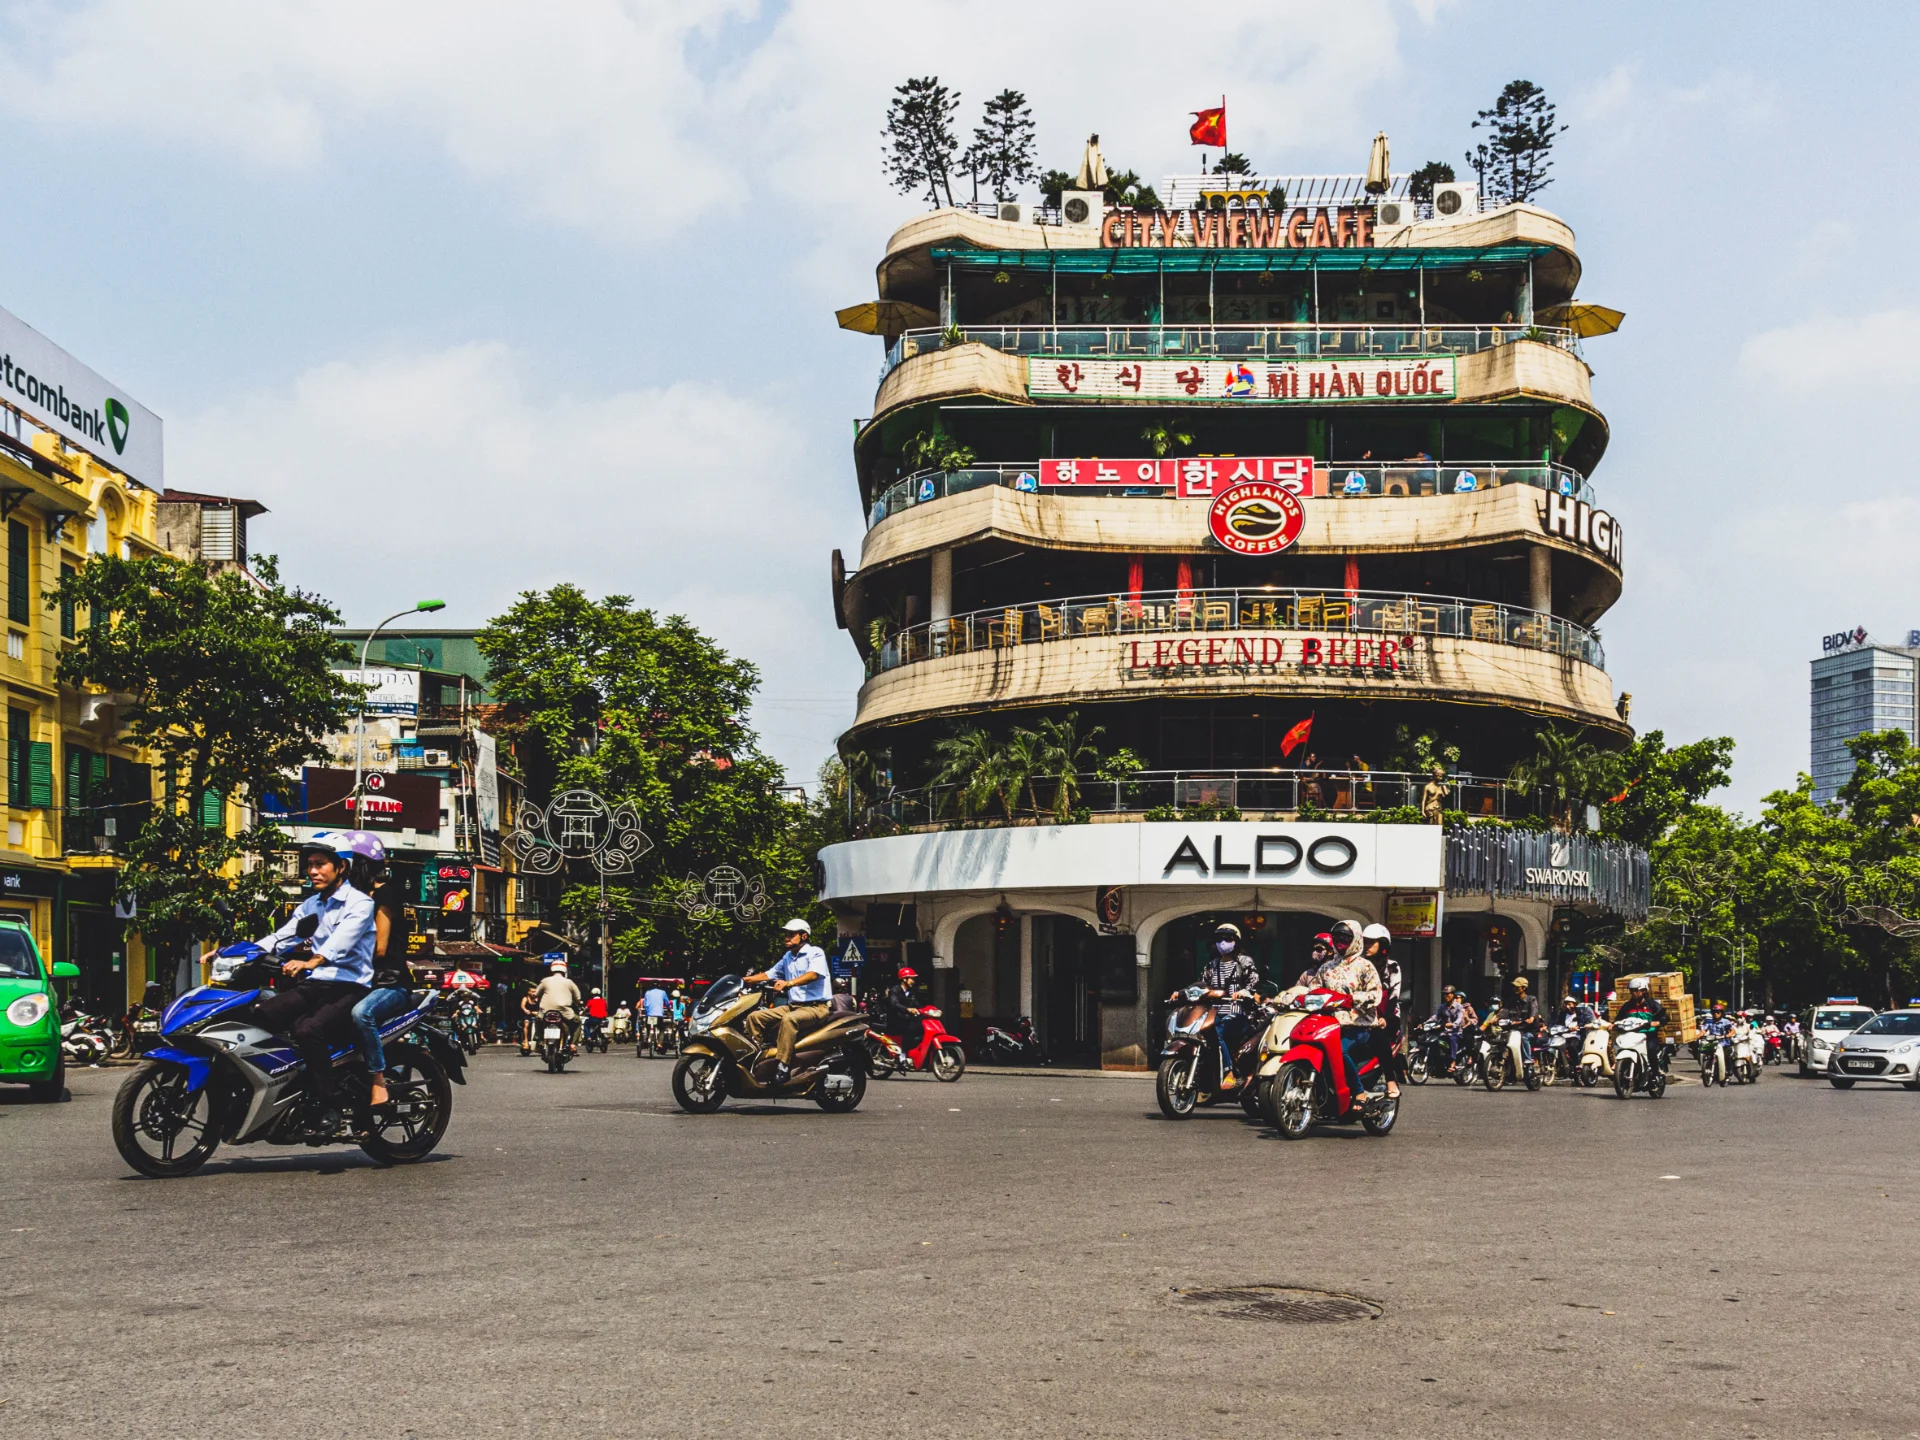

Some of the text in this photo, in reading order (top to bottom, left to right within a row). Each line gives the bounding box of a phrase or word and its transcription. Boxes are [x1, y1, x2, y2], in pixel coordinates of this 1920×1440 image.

[1102, 206, 1374, 247] CITY VIEW CAFE
[1269, 361, 1443, 397] MÌ HÀN QUỐC
[0, 354, 105, 447] tcombank
[1214, 486, 1300, 516] HIGHLANDS
[1224, 533, 1289, 552] COFFEE
[1548, 489, 1621, 564] HIGH
[1130, 637, 1283, 669] LEGEND
[1823, 630, 1854, 651] BIDV
[366, 800, 403, 813] TRANG
[1163, 835, 1358, 872] ALDO
[1525, 867, 1589, 887] SWAROVSKI
